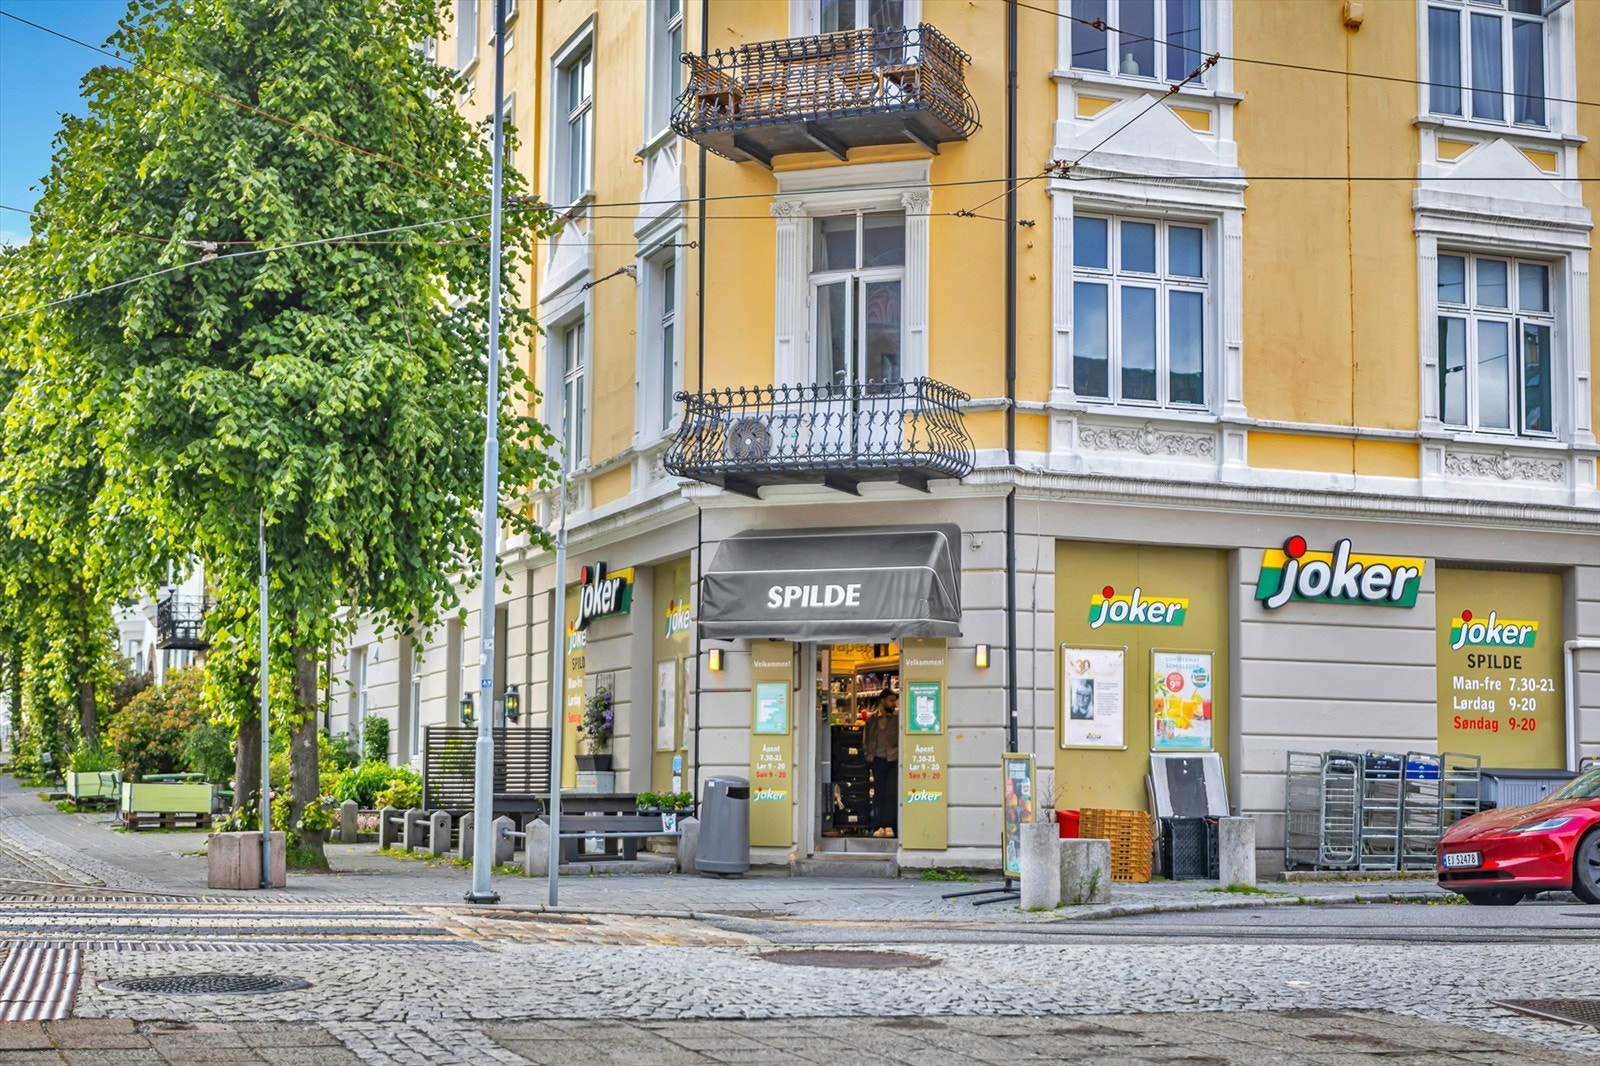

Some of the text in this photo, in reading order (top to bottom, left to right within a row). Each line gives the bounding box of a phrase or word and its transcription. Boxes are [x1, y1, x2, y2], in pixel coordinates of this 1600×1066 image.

[1263, 536, 1418, 610] joker
[575, 561, 621, 630] joker
[767, 583, 861, 609] SPILDE
[1089, 586, 1182, 629] joker
[666, 598, 690, 639] joke
[568, 621, 587, 655] joke
[1451, 610, 1533, 651] joker
[572, 656, 585, 670] SPILD
[753, 660, 791, 668] Velkommen!
[905, 658, 945, 666] Velkommen!
[1467, 654, 1522, 670] SPILDE
[1453, 676, 1555, 692] Man-fre 7.30-21
[1453, 696, 1537, 713] Lørdag 9-20
[1453, 715, 1537, 732] Søndag 9-20
[754, 787, 785, 801] joker
[907, 788, 941, 803] joker
[1456, 854, 1476, 865] 52478
